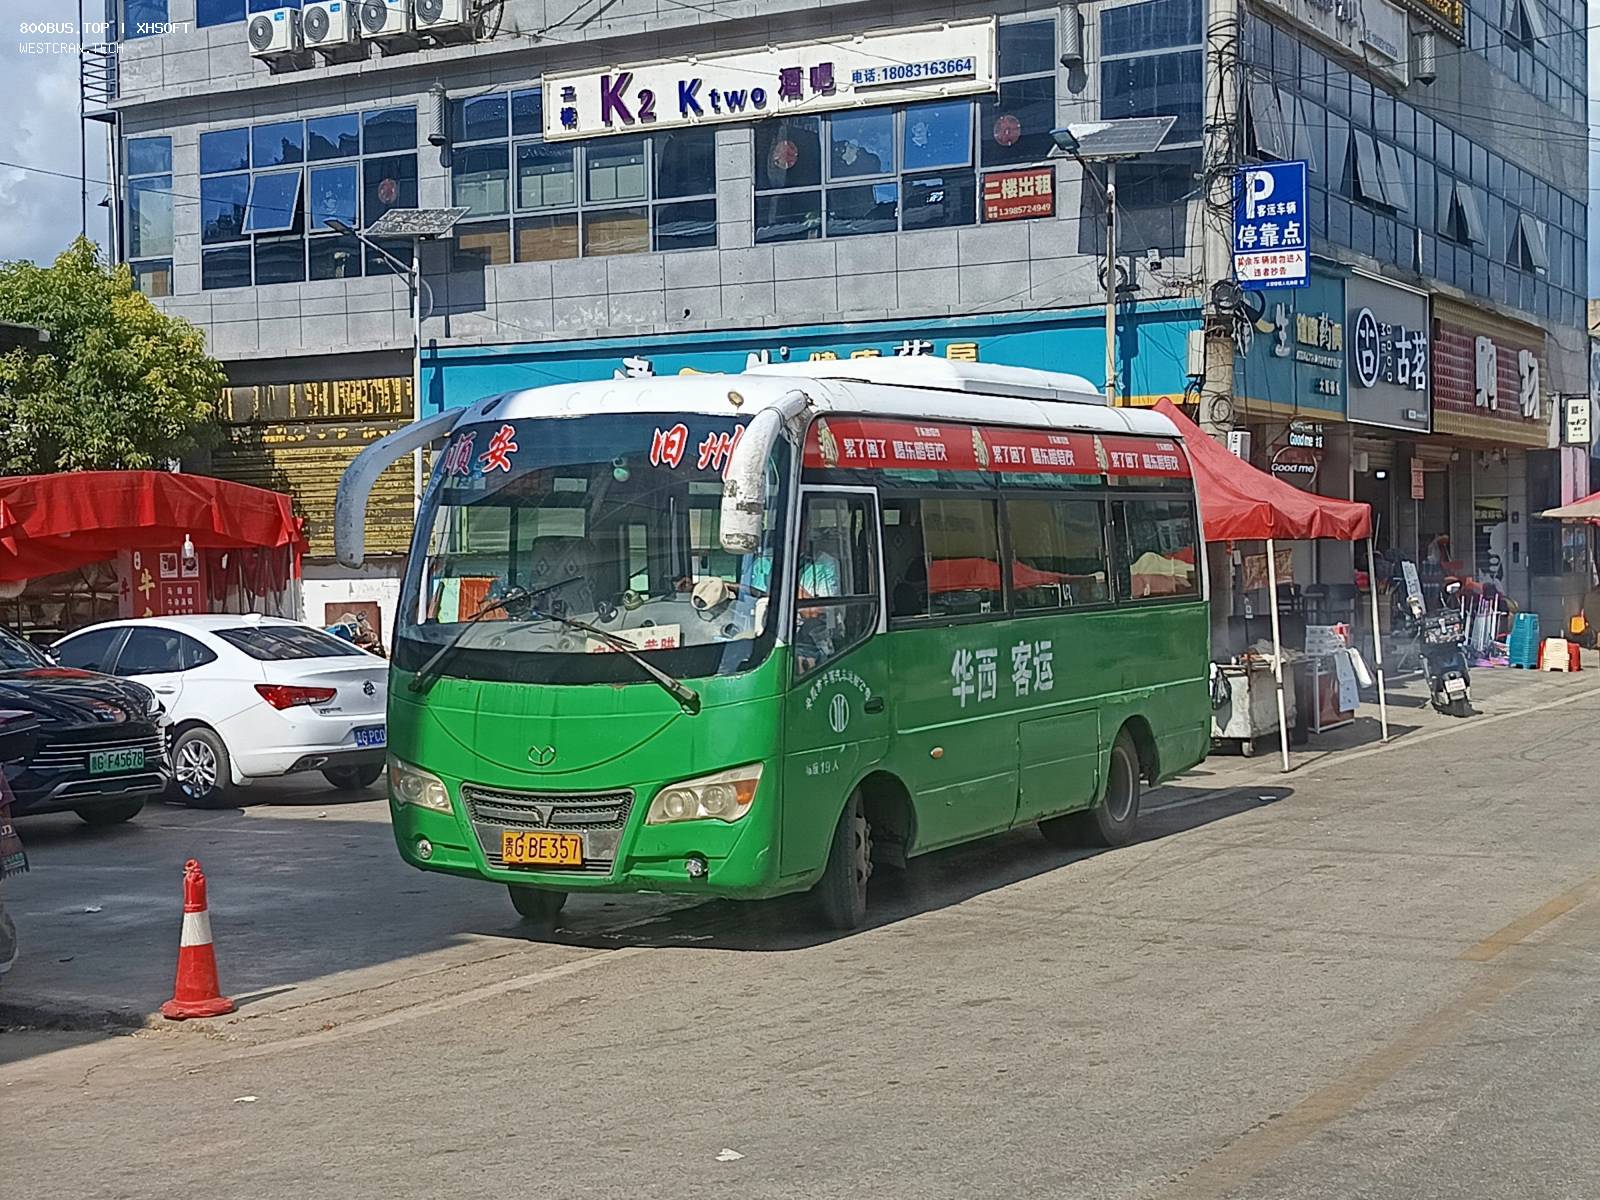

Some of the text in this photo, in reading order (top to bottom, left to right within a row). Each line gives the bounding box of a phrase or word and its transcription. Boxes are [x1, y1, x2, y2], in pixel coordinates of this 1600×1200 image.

[985, 174, 1052, 200] 二楼出租
[1246, 171, 1274, 219] P
[1257, 201, 1297, 218] 客运车辆
[1238, 220, 1302, 248] 停靠点
[1395, 325, 1428, 391] 古茗
[1271, 463, 1315, 473] Good me
[951, 640, 1054, 707] 华西 客运
